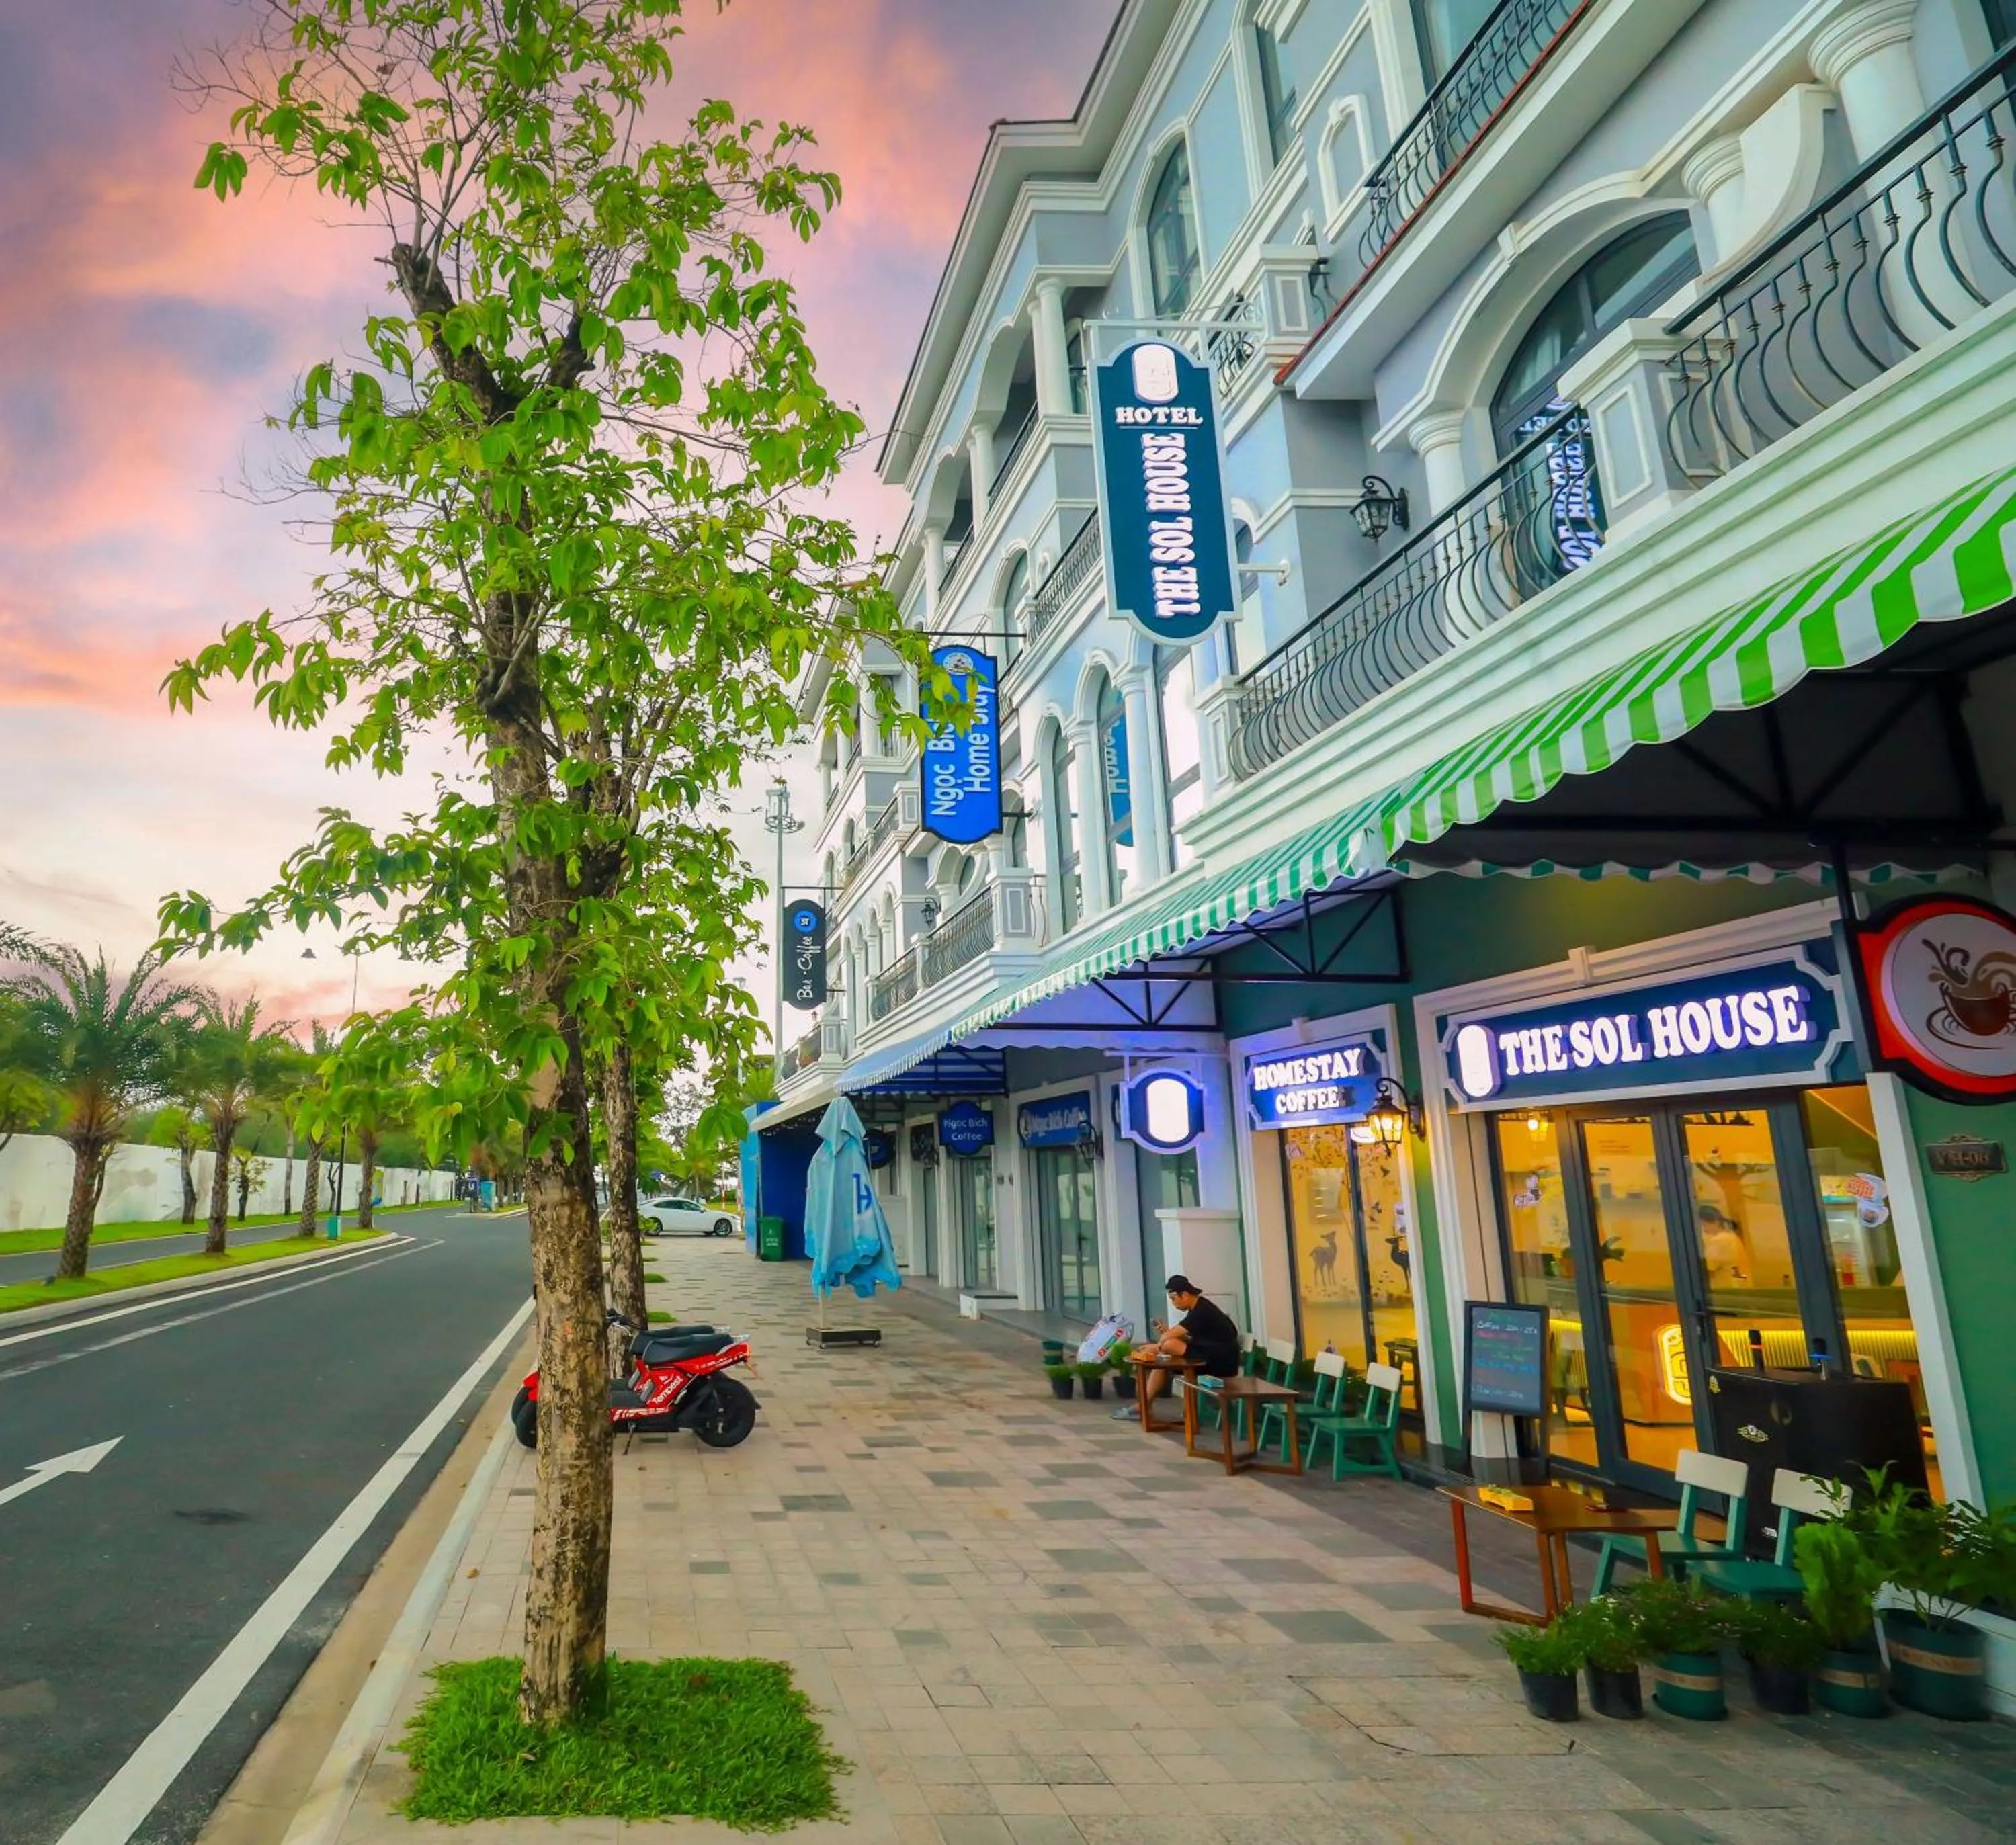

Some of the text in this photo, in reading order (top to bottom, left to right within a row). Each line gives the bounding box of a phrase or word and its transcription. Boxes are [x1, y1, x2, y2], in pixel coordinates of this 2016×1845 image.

[1116, 406, 1203, 425] HOTEL
[1141, 432, 1201, 618] THE SOL HOUSE
[963, 732, 991, 792] Home
[796, 936, 821, 970] Coffee
[1499, 986, 1808, 1075] THE SOL HOUSE
[1253, 1048, 1361, 1091] HOMESTAY
[1275, 1086, 1339, 1115] COFFEE
[951, 1132, 984, 1140] Coffee
